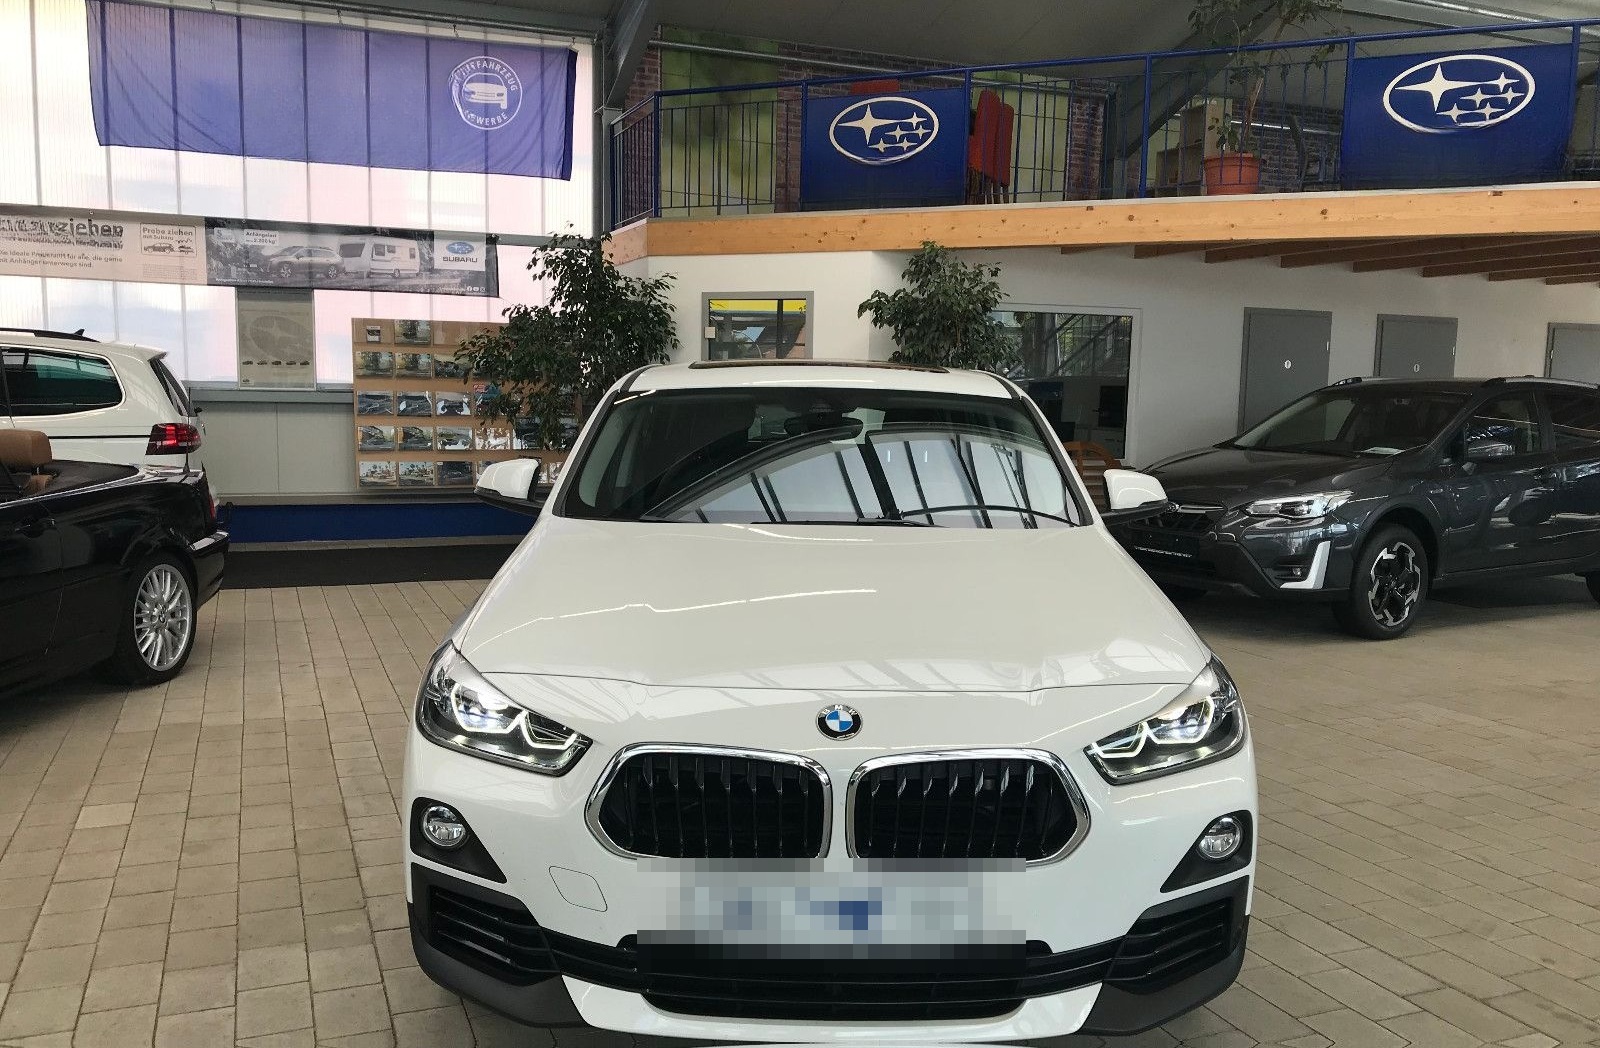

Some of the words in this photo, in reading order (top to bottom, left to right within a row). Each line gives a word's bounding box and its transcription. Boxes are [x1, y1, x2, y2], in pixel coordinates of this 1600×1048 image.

[453, 60, 519, 91] FAHRZEUG
[142, 226, 166, 235] Probe
[167, 228, 193, 236] ziehen
[821, 704, 858, 716] BMW
